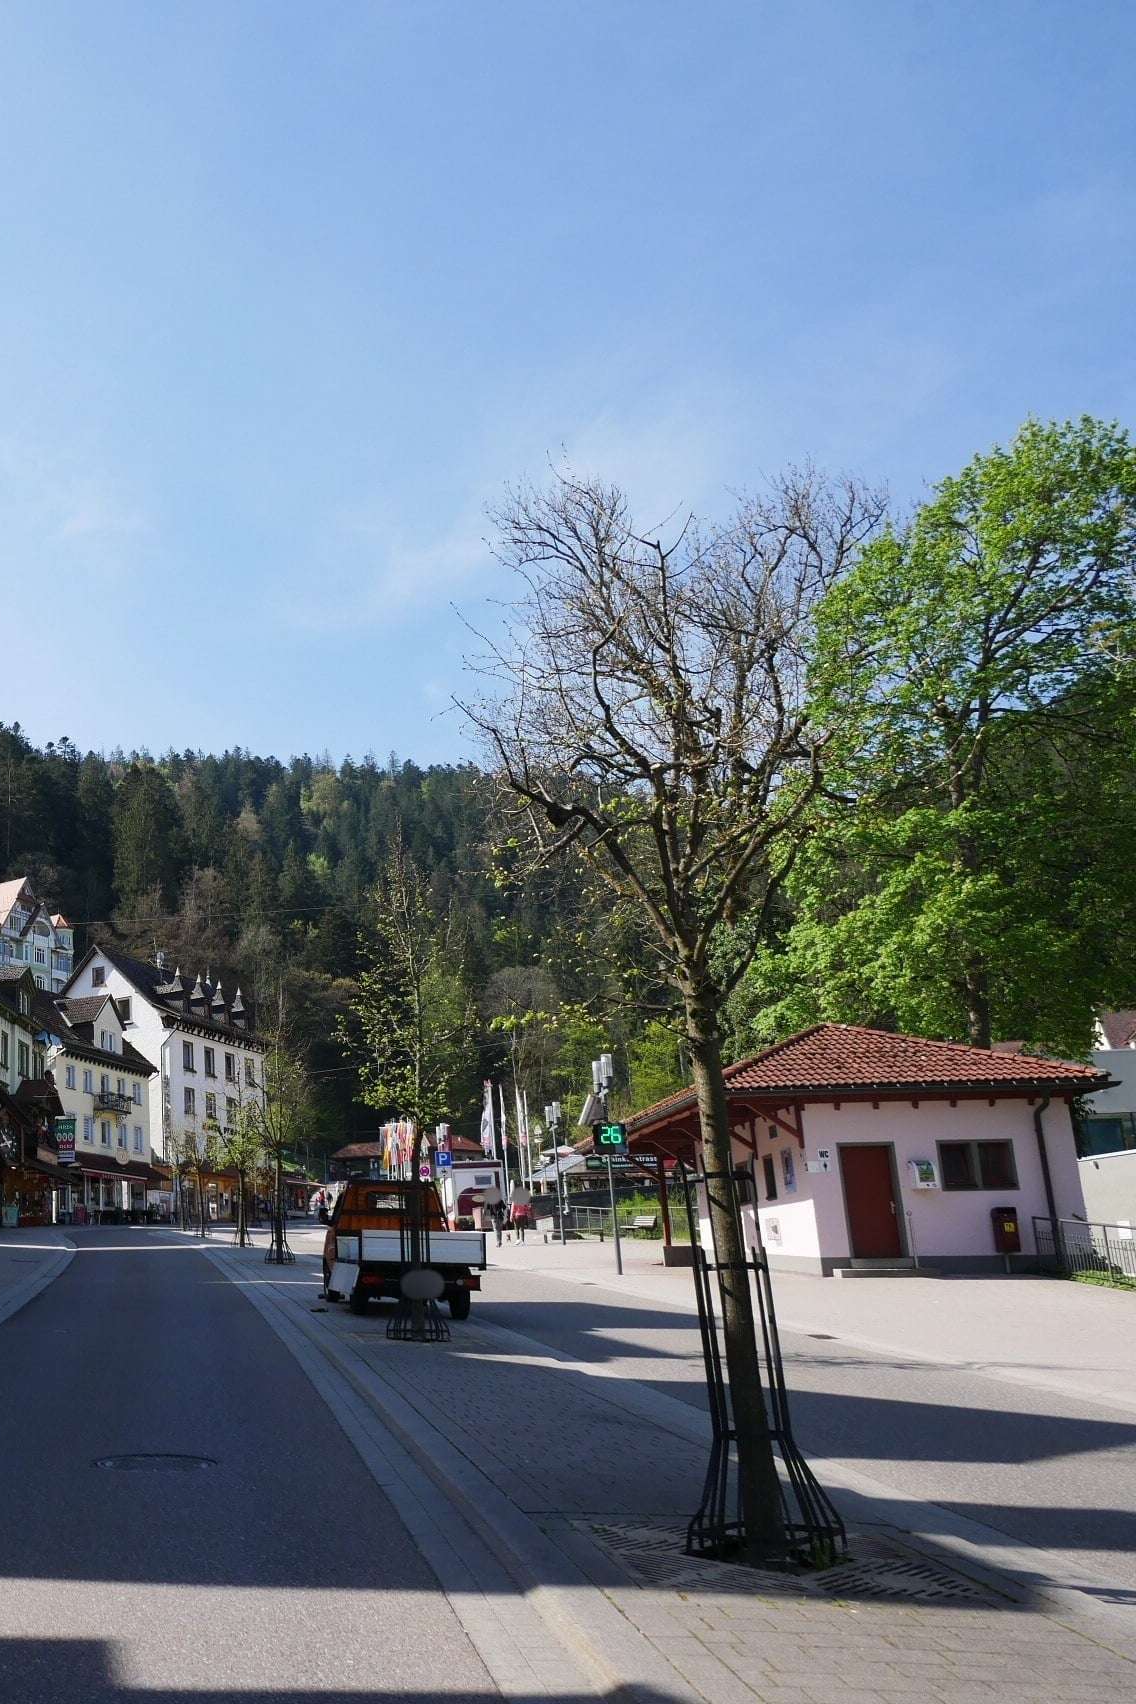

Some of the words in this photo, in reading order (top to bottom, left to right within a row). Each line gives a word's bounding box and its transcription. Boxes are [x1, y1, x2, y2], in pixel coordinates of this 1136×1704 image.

[600, 1126, 622, 1144] 26
[439, 1153, 447, 1165] P
[818, 1150, 829, 1158] WC
